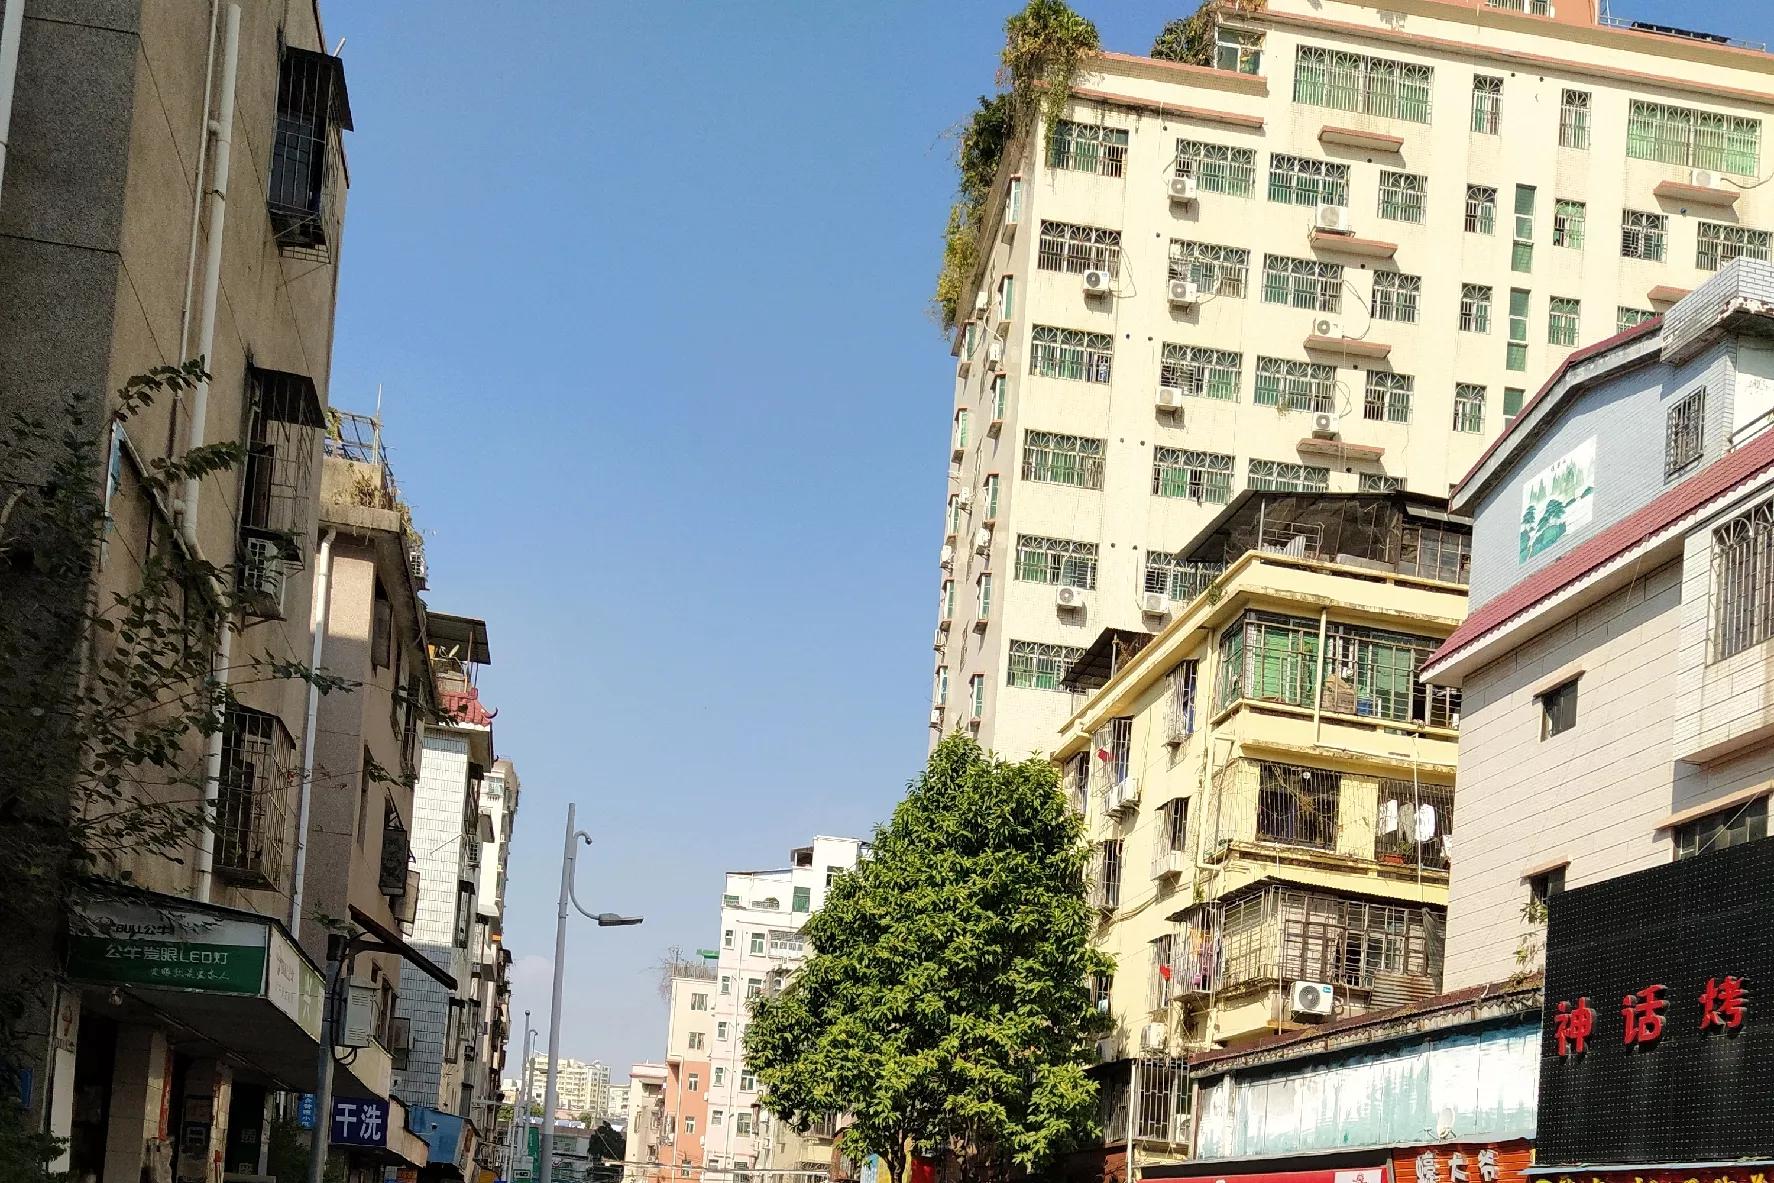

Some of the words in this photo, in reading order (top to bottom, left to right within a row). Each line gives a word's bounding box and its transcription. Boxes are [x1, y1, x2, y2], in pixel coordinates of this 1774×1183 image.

[1553, 974, 1747, 1057] 神话烤
[335, 1103, 382, 1140] 干洗
